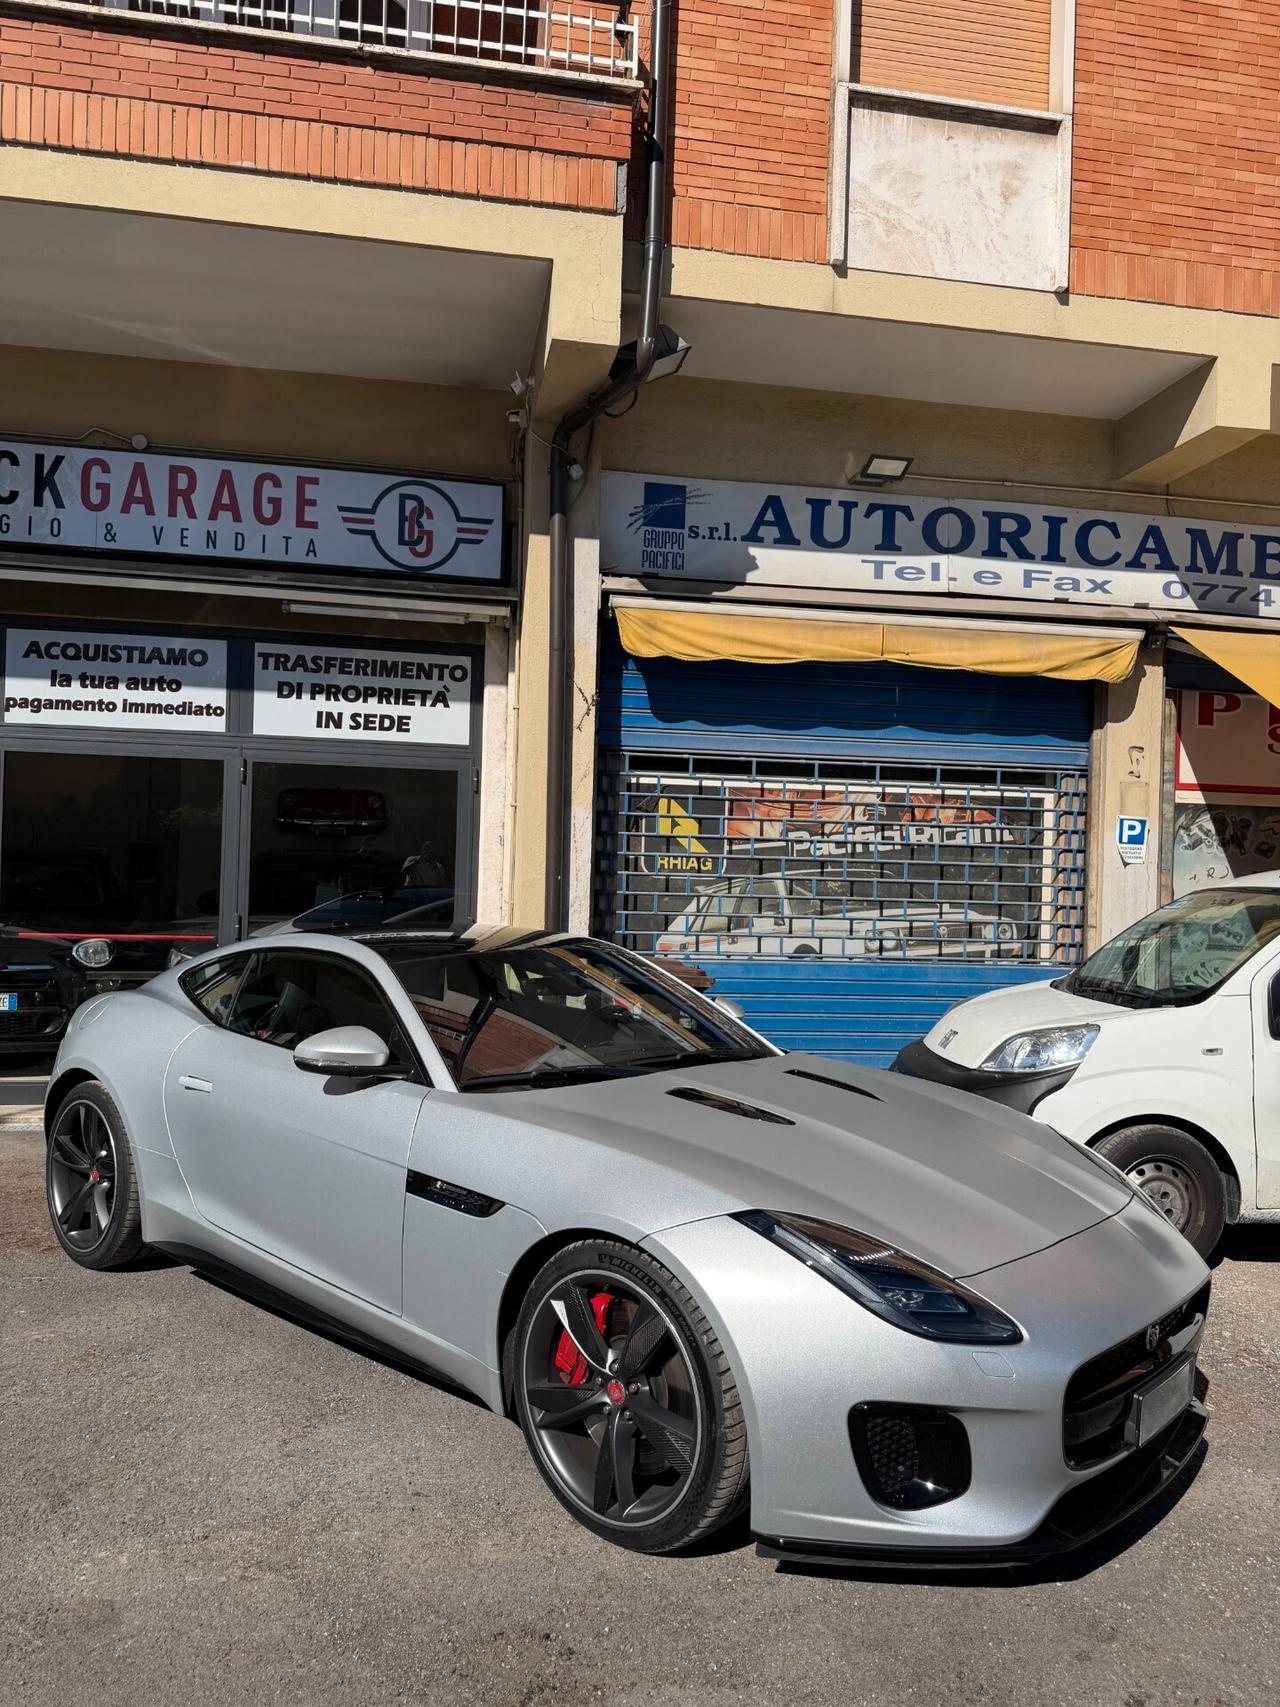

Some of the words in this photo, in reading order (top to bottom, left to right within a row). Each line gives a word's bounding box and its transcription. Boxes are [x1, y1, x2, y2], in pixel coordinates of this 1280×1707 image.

[103, 522, 117, 543] &
[152, 525, 318, 558] VENDITA
[643, 529, 685, 550] GRUPPO
[687, 522, 738, 542] s.r.l.
[641, 549, 685, 571] PACIFICI
[861, 559, 957, 582] Tel.
[972, 569, 1003, 586] e
[1023, 568, 1113, 595] Fax
[1162, 580, 1276, 607] 0774
[22, 640, 209, 667] ACQUISTIAMO
[257, 651, 469, 683] TRASFERIMENTO
[50, 668, 72, 688] la
[78, 671, 120, 690] tua
[125, 674, 183, 693] auto
[276, 680, 304, 700] DI
[309, 682, 451, 708] PROPRIETÀ
[4, 696, 118, 713] pagamento
[121, 698, 225, 717] immediato
[315, 710, 344, 730] IN
[348, 712, 412, 733] SEDE
[657, 855, 713, 872] RHIAG
